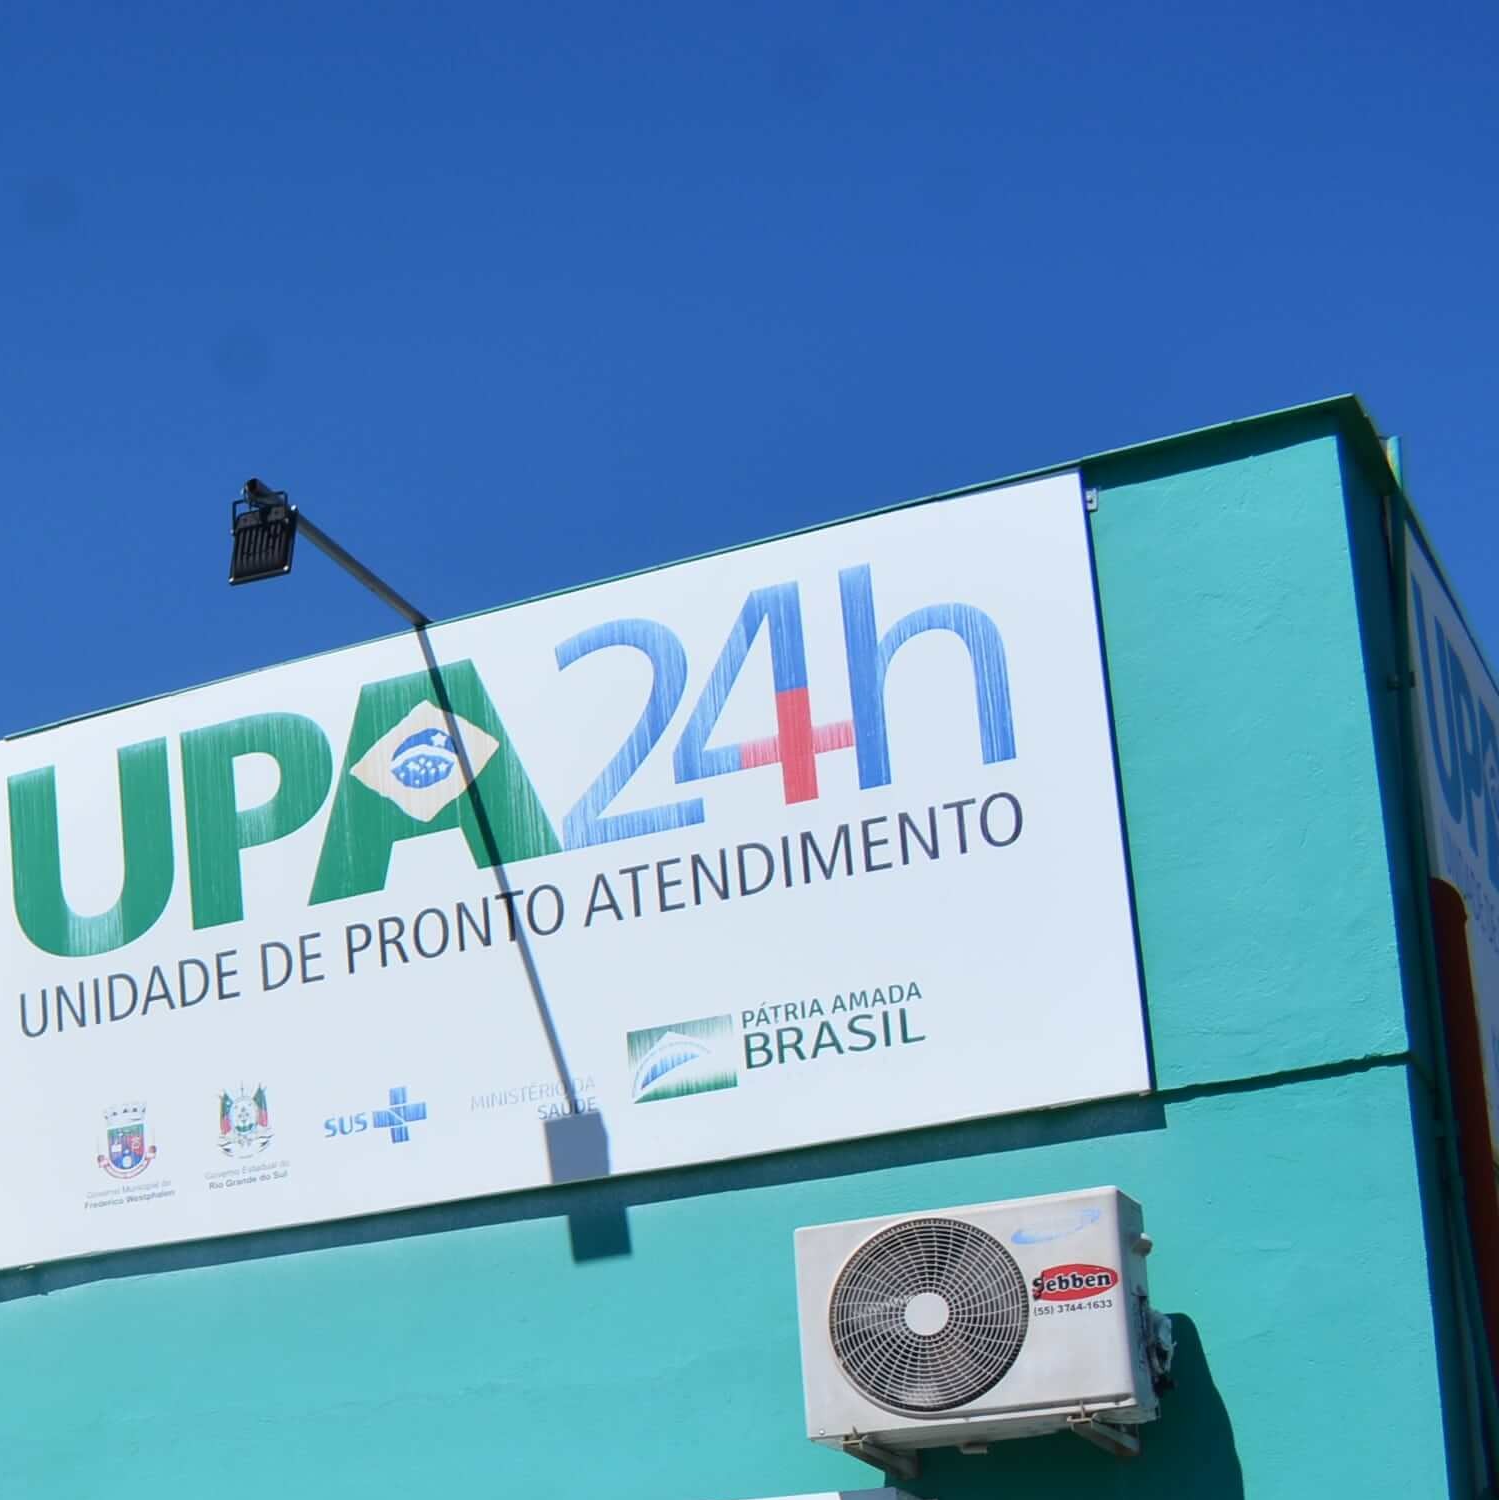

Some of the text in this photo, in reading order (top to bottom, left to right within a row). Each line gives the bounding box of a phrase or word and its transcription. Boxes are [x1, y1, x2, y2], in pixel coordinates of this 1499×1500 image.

[6, 562, 1017, 958] UPA 24h
[19, 791, 1024, 1038] UNIDADE DE PRONTO ATENDIMENTO
[741, 981, 923, 1029] PÁTRIA AMADA
[742, 1007, 927, 1070] BRASIL
[324, 1111, 368, 1138] SUS
[209, 1178, 224, 1190] Rio
[225, 1175, 257, 1189] Grande
[272, 1168, 289, 1181] Sul
[1034, 1305, 1054, 1317] (55)
